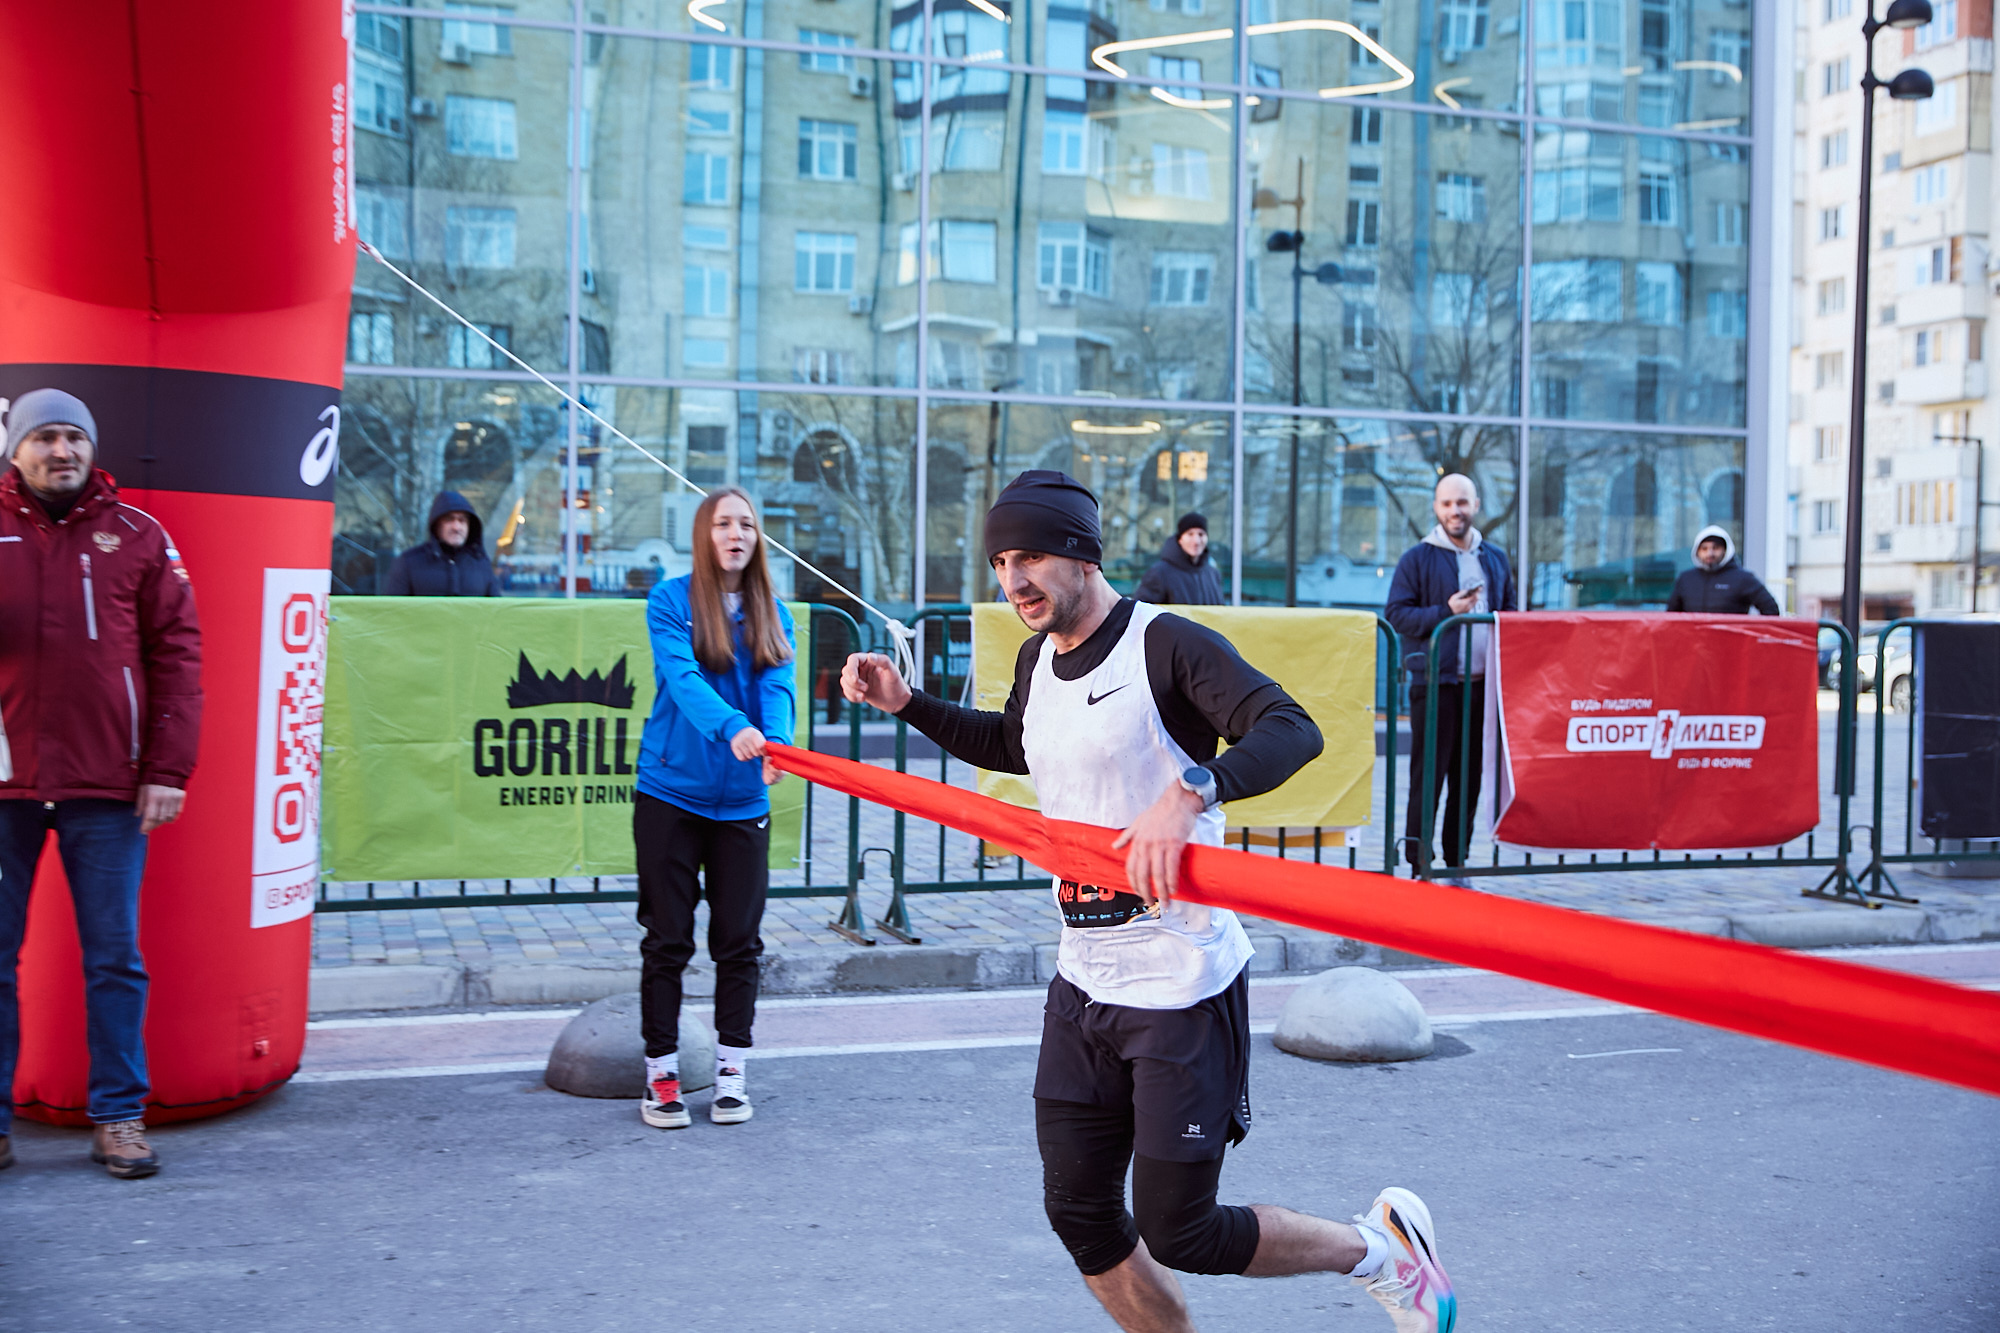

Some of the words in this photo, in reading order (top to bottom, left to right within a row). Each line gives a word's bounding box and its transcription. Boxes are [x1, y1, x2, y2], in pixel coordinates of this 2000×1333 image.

[1576, 724, 1648, 744] СПОРТ
[1680, 723, 1757, 743] ЛИДЕР
[500, 786, 578, 806] ENERGY
